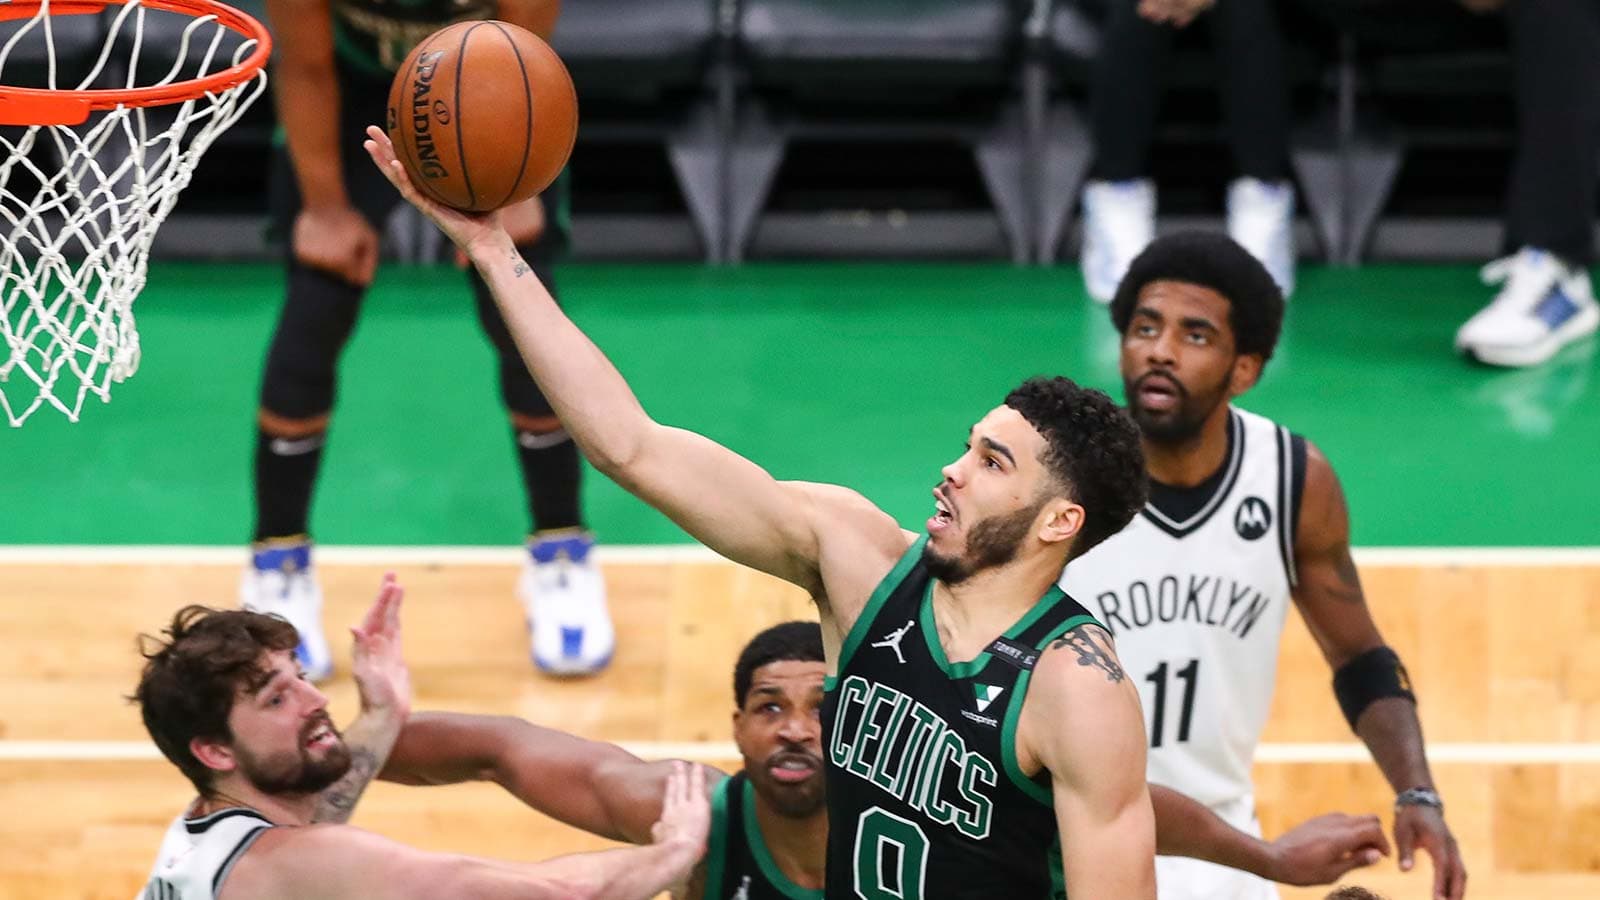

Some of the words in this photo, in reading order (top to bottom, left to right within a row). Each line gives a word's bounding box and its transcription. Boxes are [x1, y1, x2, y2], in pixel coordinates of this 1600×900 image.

[412, 50, 449, 180] SPALDING
[1097, 574, 1270, 640] ROOKLYN
[1145, 659, 1199, 749] 11
[829, 675, 998, 840] CELTICS
[853, 806, 930, 900] 0
